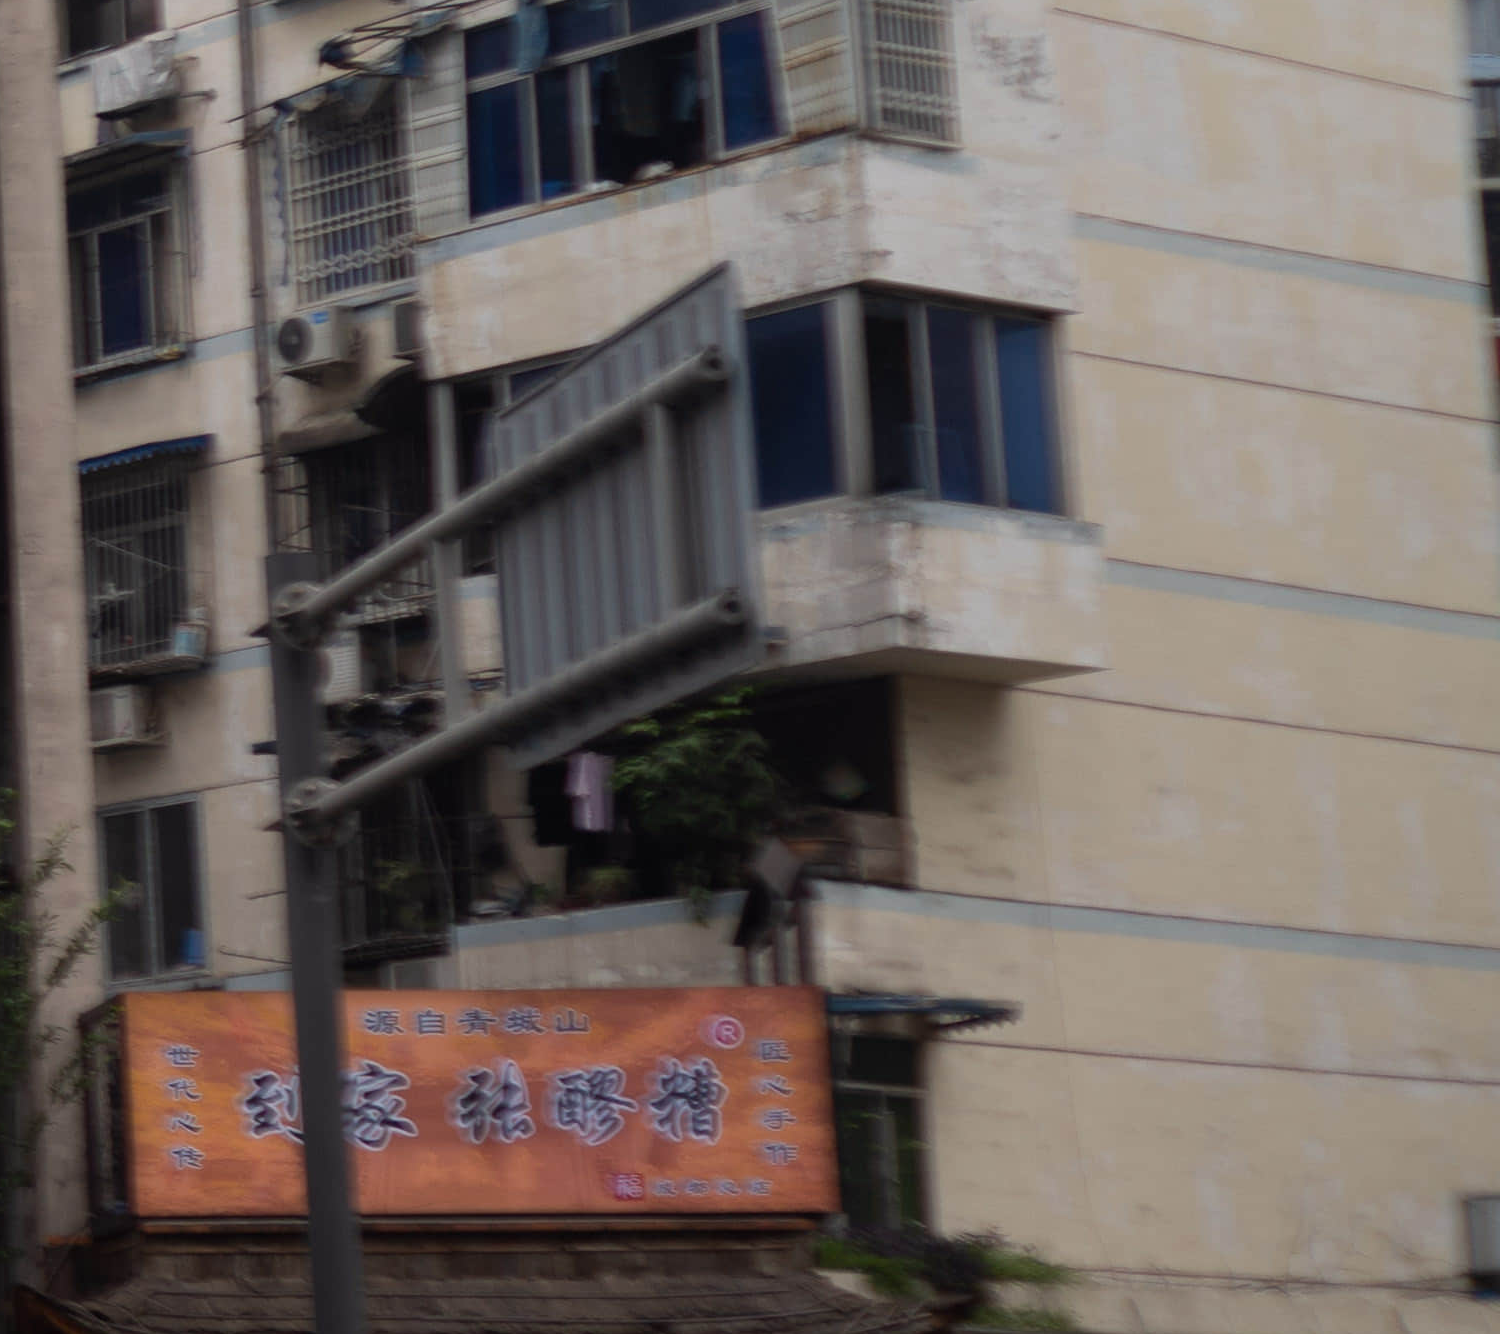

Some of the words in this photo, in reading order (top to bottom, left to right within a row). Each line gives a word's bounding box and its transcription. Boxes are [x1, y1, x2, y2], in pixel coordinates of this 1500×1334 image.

[365, 1007, 592, 1037] 源自青城山
[166, 1043, 204, 1171] 世代心传
[758, 1037, 800, 1167] 匠心手作
